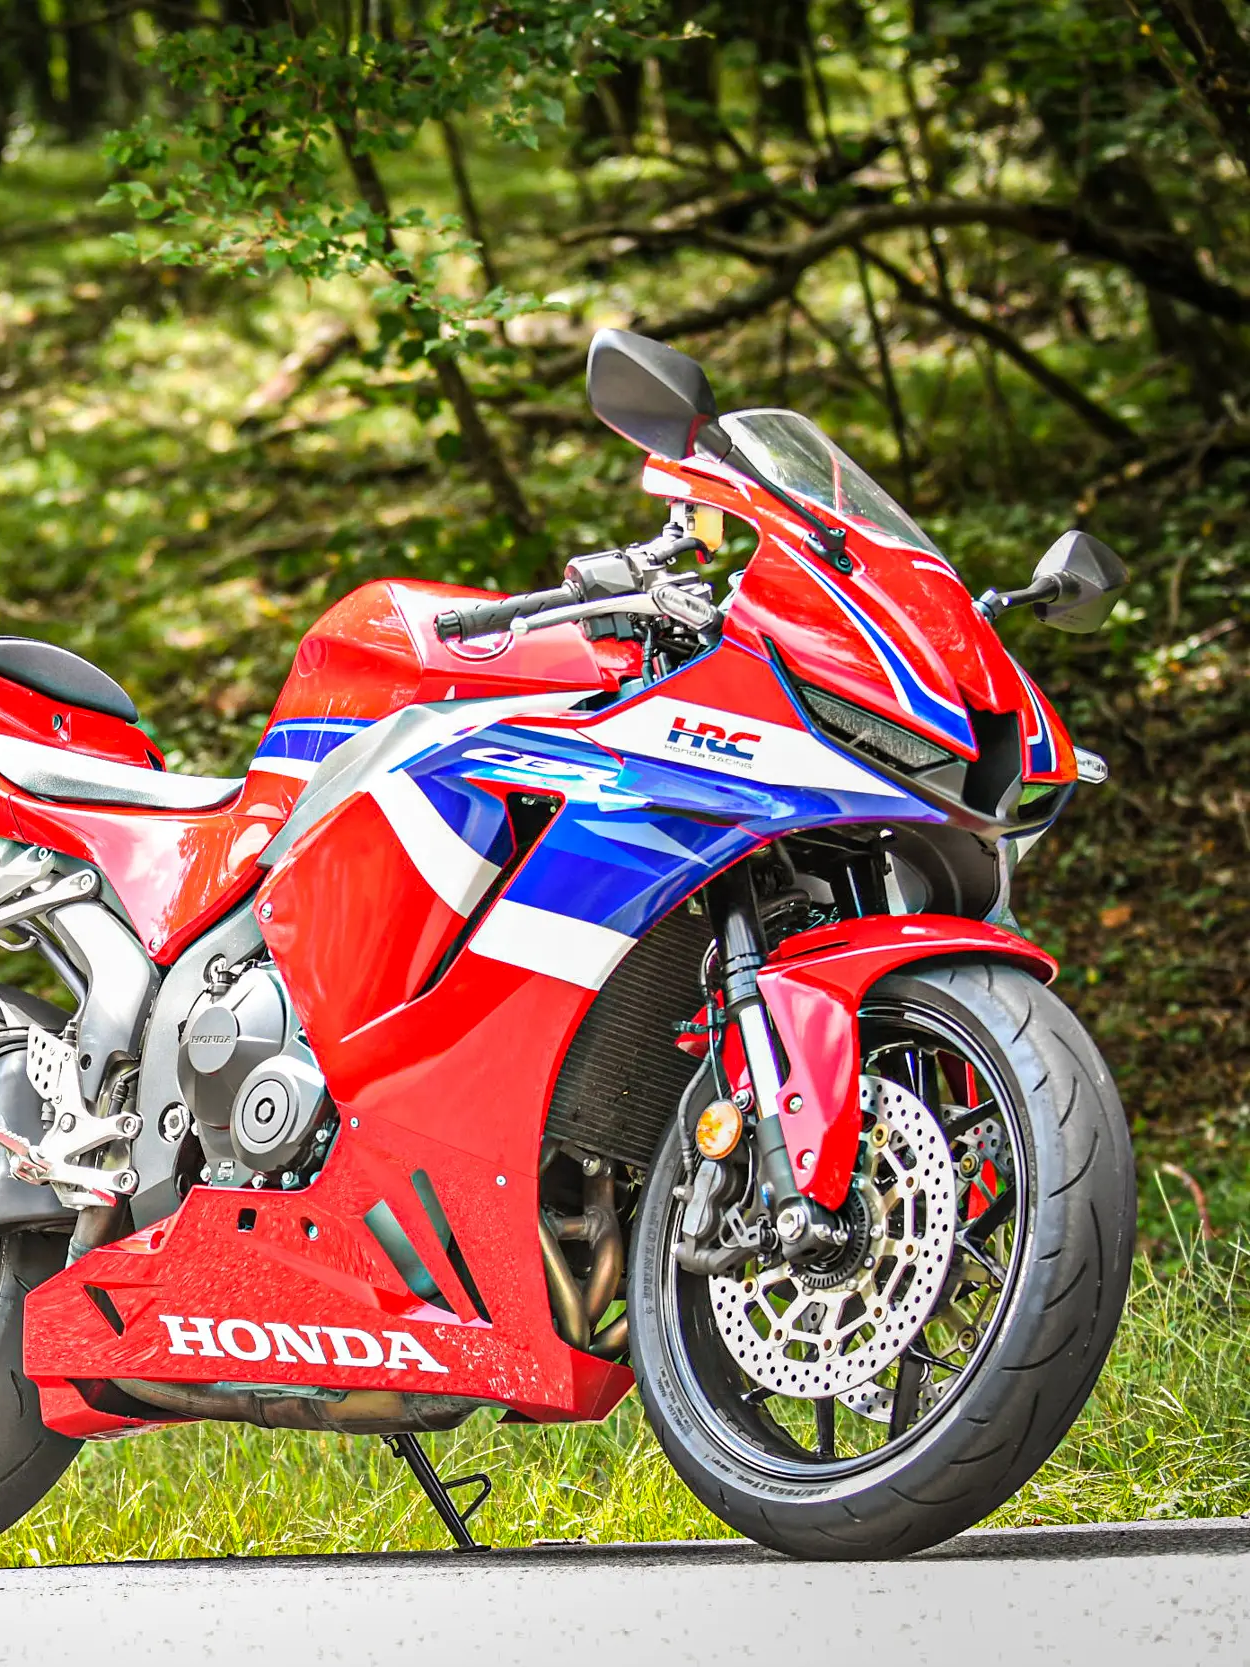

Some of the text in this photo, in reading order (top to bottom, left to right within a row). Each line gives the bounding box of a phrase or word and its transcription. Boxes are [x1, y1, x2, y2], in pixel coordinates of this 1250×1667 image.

[666, 717, 762, 761] HRC
[190, 1034, 234, 1045] HONDA
[158, 1314, 450, 1374] HONDA
